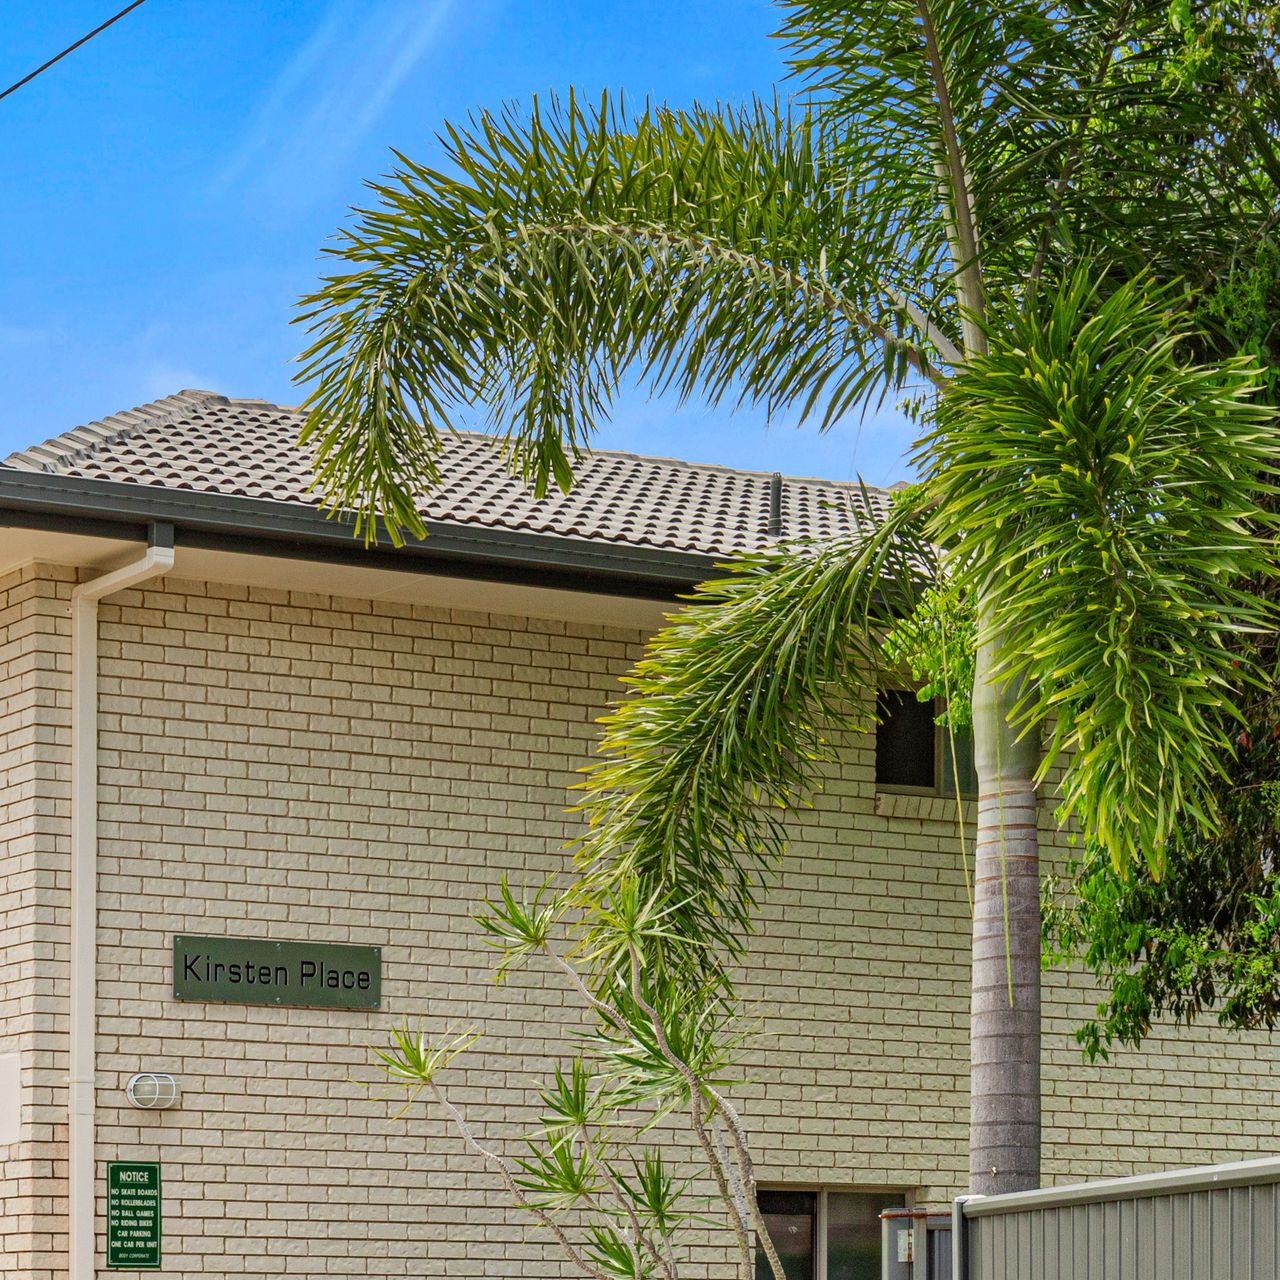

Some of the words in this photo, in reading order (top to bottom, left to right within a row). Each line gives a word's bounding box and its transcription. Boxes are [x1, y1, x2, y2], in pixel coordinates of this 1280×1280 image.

[184, 954, 288, 986] Kirsten
[300, 960, 372, 990] Place
[119, 1171, 149, 1182] NOTICE
